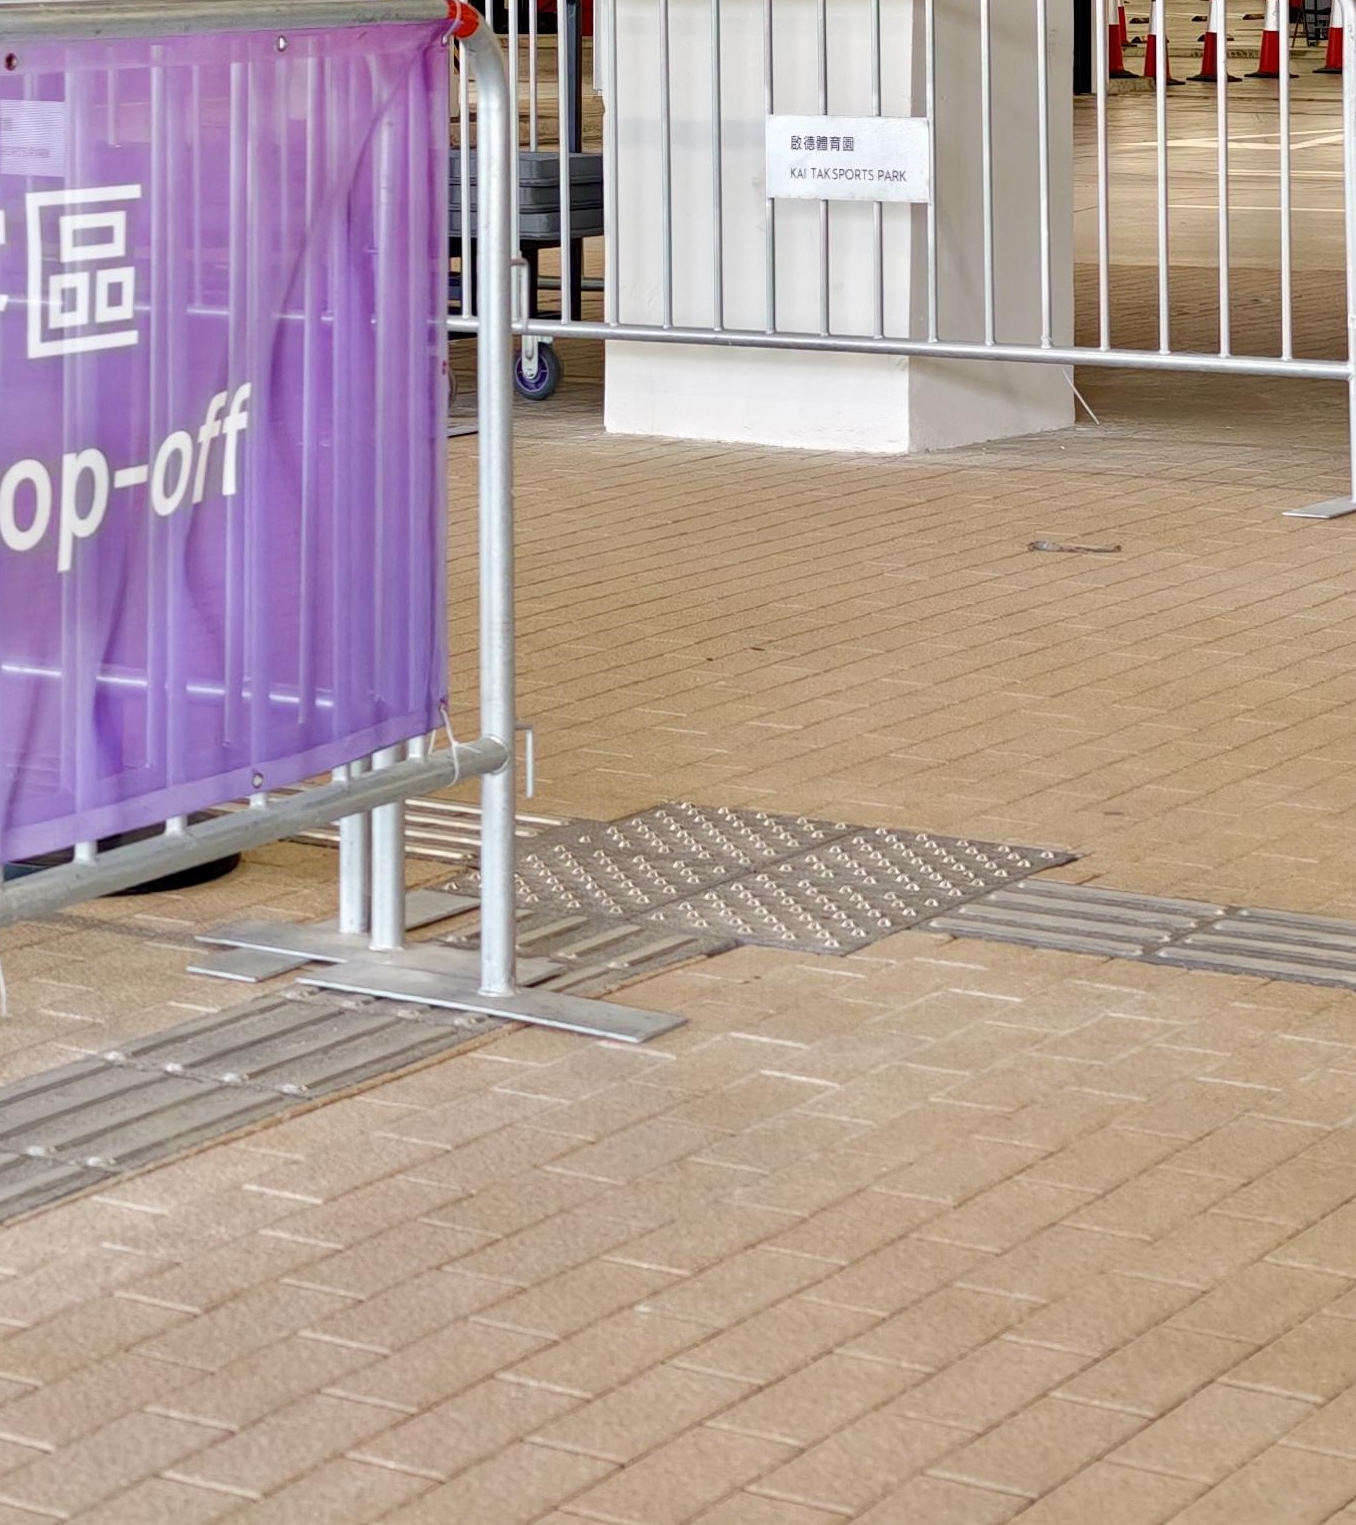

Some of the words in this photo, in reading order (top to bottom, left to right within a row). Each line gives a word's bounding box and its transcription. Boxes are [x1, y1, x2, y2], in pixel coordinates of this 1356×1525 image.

[790, 135, 855, 152] 啟德體育園
[790, 167, 807, 179] KAI
[877, 169, 908, 182] PARK
